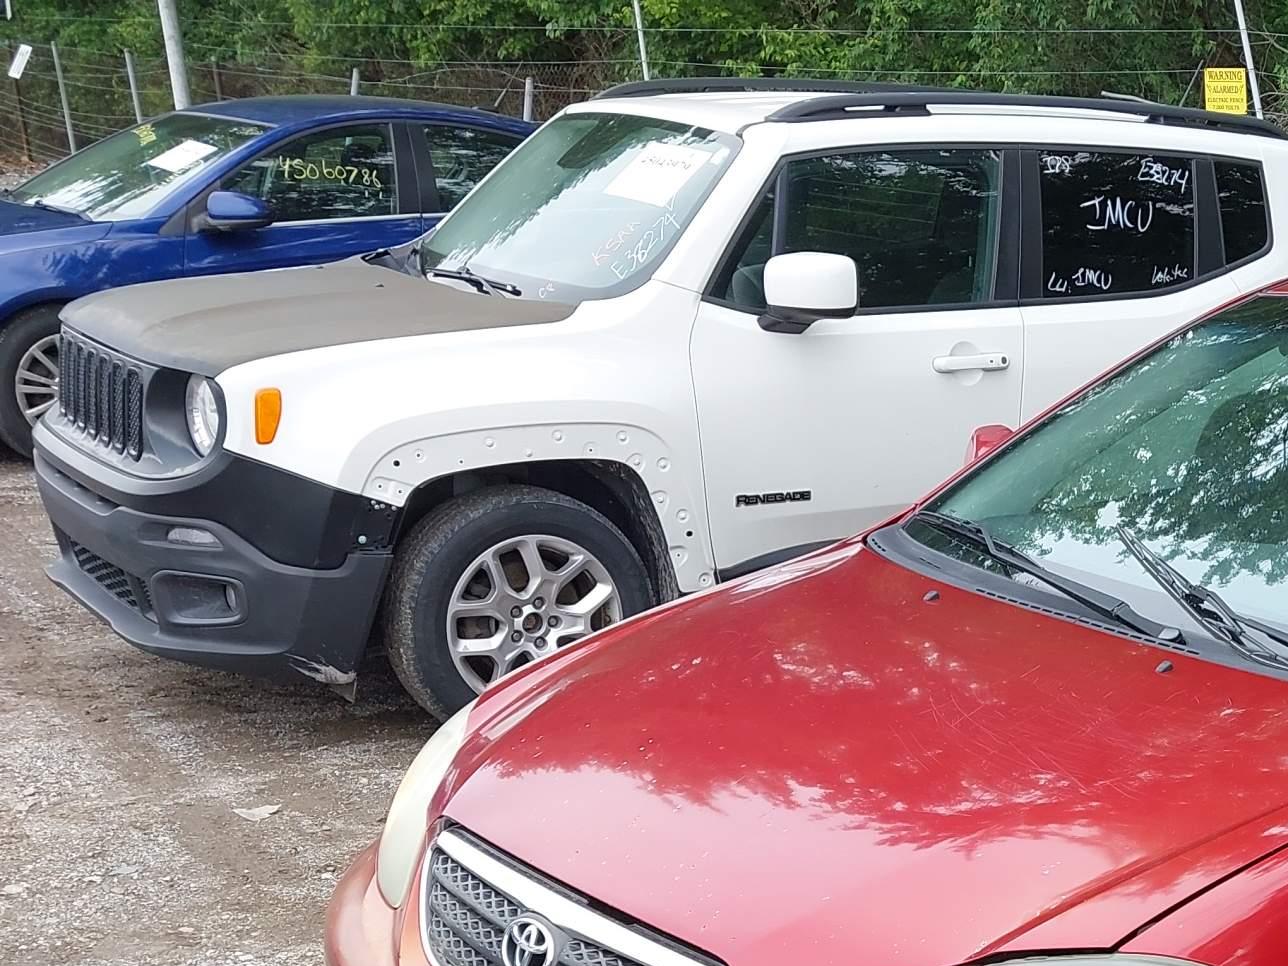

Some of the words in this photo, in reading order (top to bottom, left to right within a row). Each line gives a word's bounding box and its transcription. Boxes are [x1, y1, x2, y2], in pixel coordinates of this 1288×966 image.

[1207, 70, 1243, 81] WARNING
[1212, 85, 1239, 94] ALARMED
[278, 154, 382, 189] 45060786
[1080, 195, 1154, 233] IMCU
[1072, 267, 1112, 290] IMCU
[735, 490, 812, 508] RENEGADE
